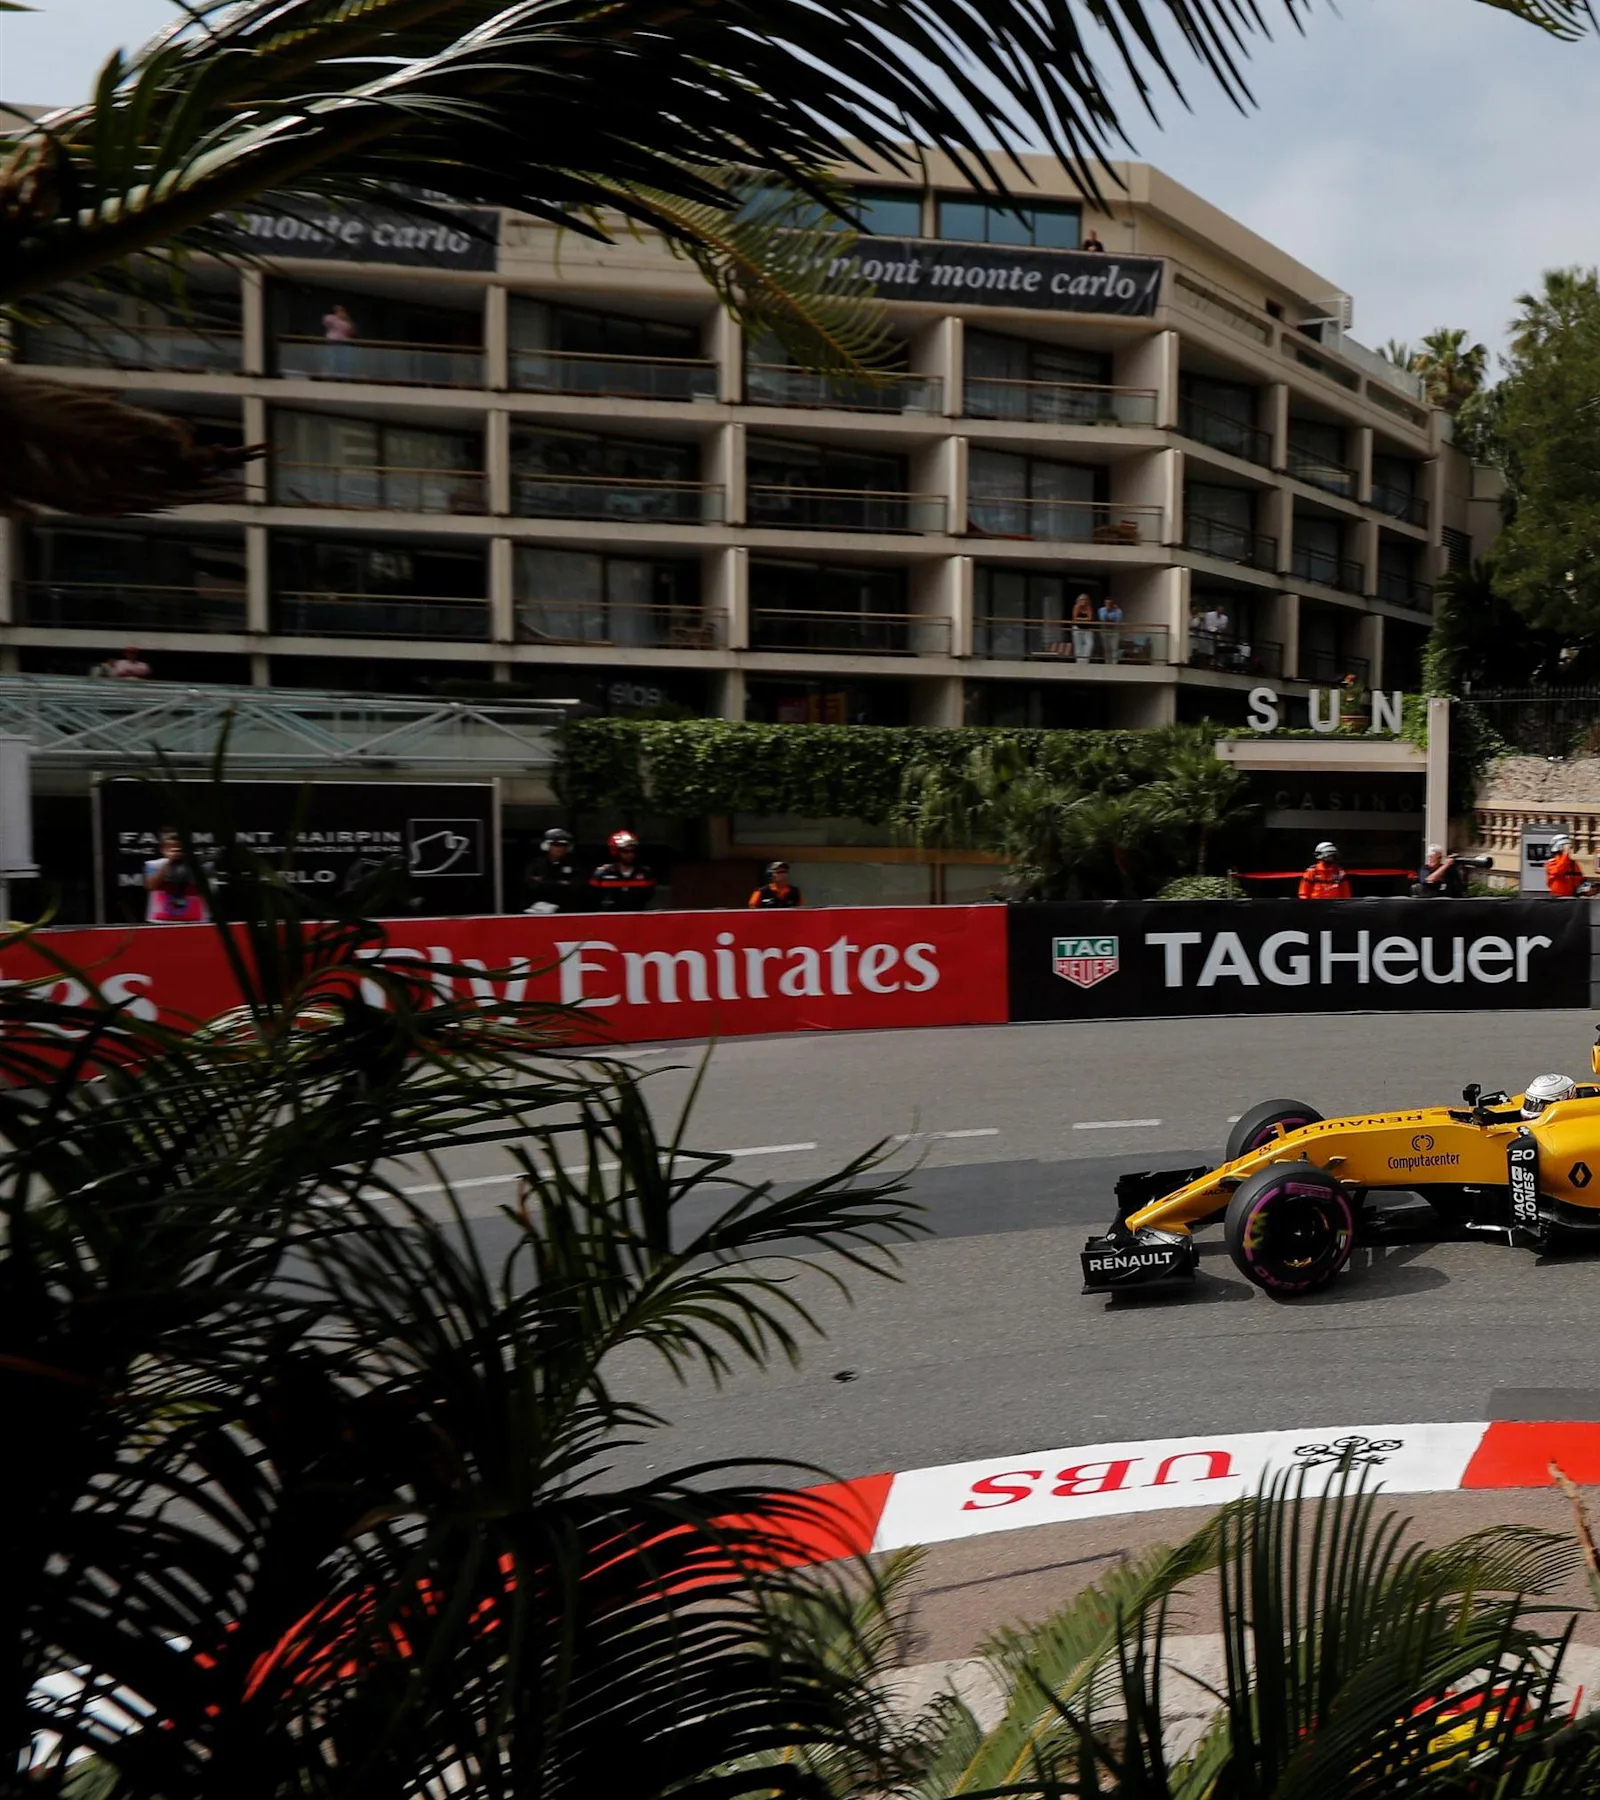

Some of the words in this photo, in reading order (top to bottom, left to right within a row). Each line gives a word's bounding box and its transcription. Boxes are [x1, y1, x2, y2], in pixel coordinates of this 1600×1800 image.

[370, 219, 472, 255] carlo
[930, 258, 1043, 293] monte
[1050, 264, 1136, 300] carlo
[1246, 687, 1404, 734] SUN
[1274, 790, 1415, 812] CASINO
[1058, 939, 1114, 957] TAG
[554, 931, 940, 1009] Emirates
[1055, 959, 1117, 985] HEUER
[1297, 1114, 1423, 1137] RENAULT
[1387, 1152, 1461, 1173] Computacenter
[1512, 1181, 1527, 1221] JACK
[1089, 1251, 1174, 1272] RENAULT
[960, 1450, 1241, 1511] UBS
